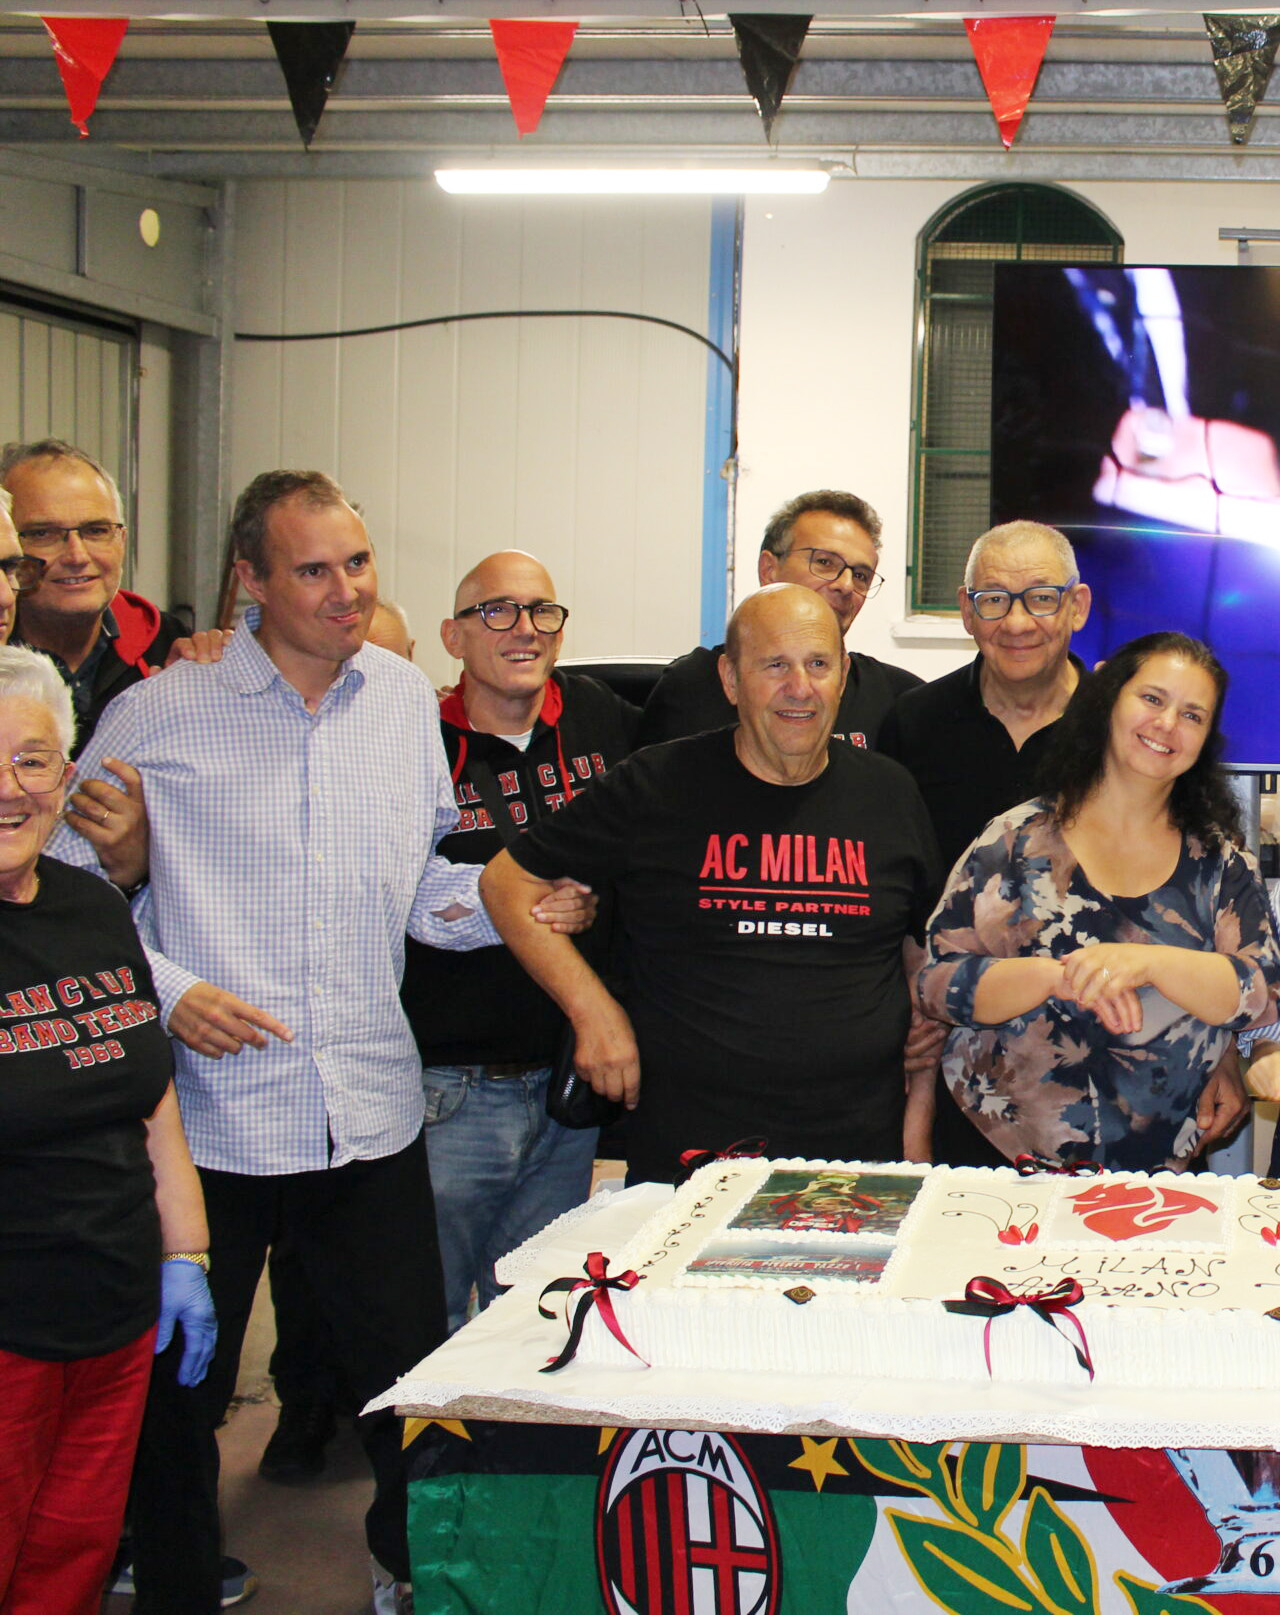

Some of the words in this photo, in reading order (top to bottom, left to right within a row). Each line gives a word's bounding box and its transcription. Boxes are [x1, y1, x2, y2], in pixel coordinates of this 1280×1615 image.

[699, 833, 749, 881] AC
[760, 834, 869, 886] MILAN
[698, 898, 767, 911] STYLE
[775, 901, 871, 916] PARTNER
[738, 920, 833, 937] DIESEL
[62, 1039, 126, 1069] 1968
[629, 1429, 735, 1484] ACM
[1249, 1539, 1275, 1578] 6
